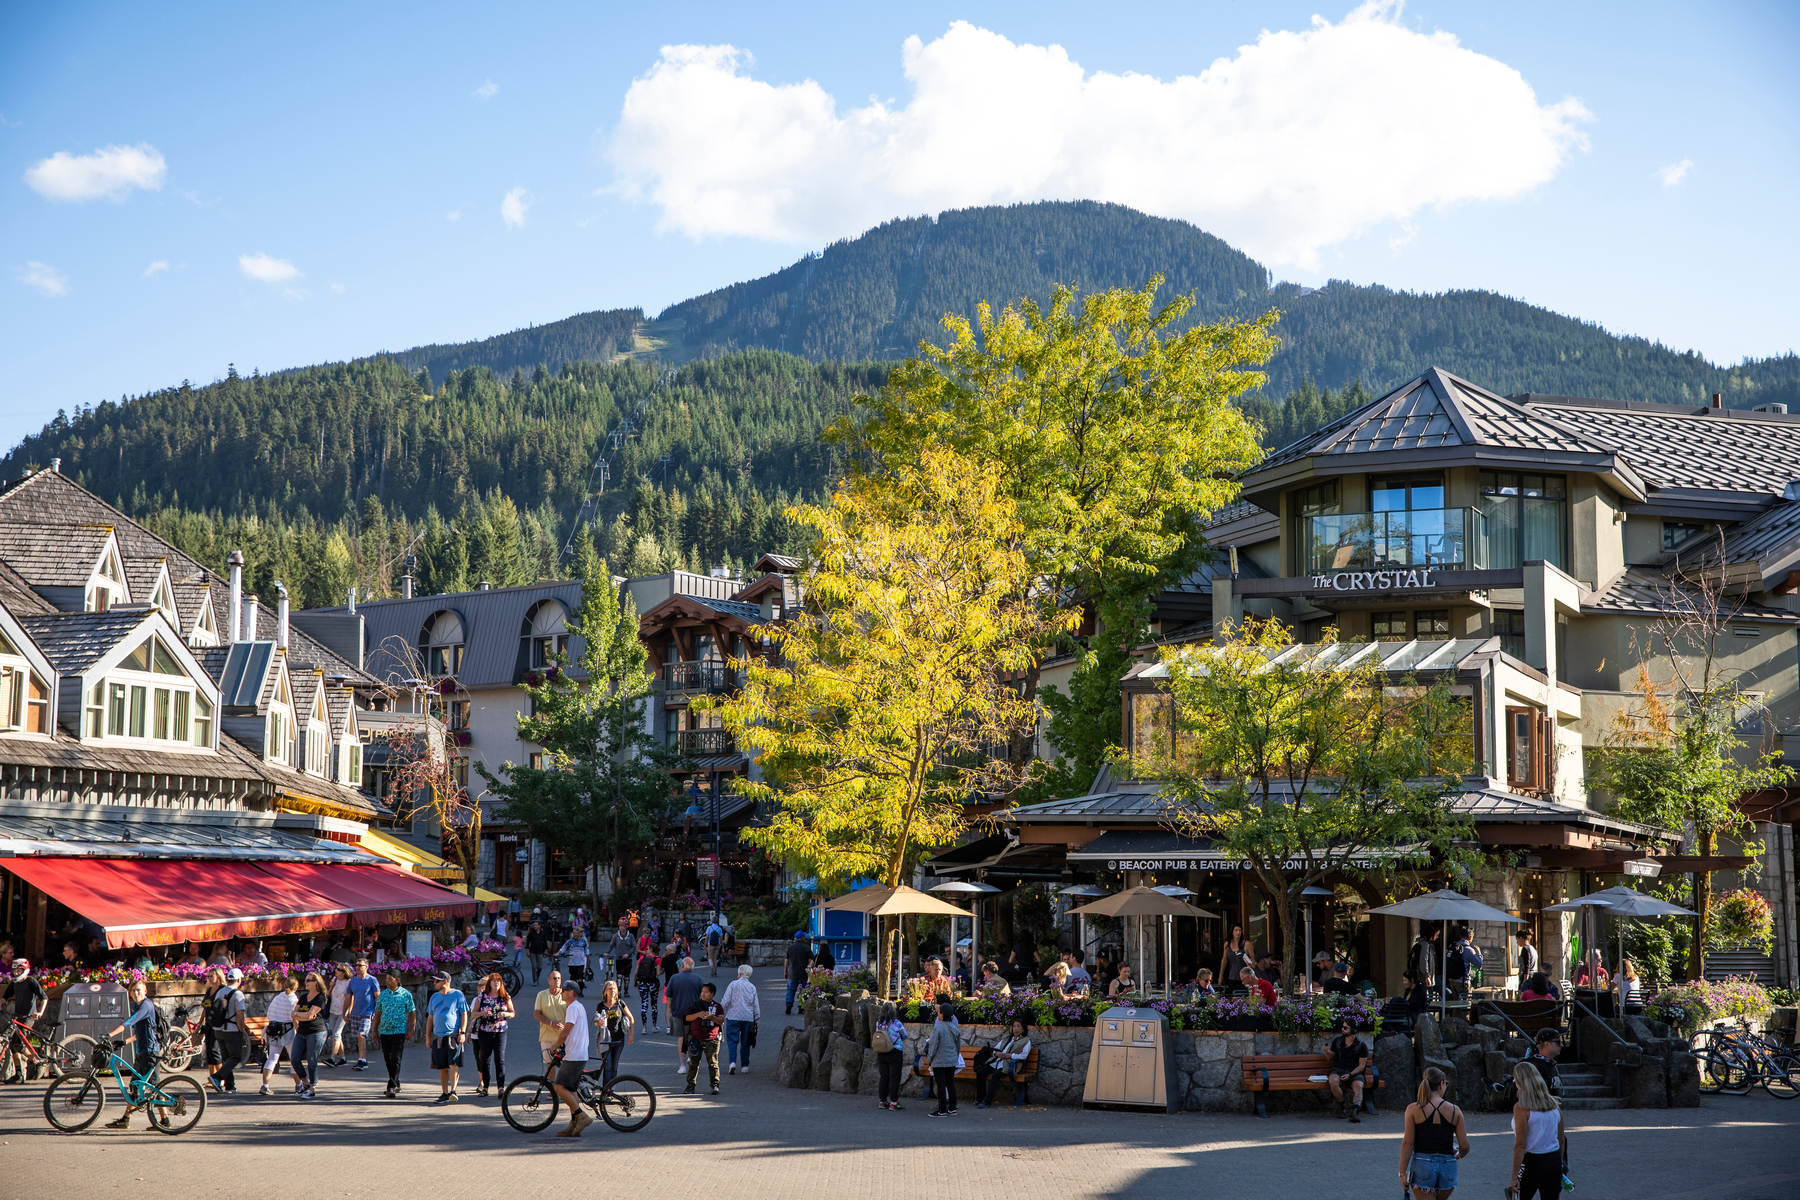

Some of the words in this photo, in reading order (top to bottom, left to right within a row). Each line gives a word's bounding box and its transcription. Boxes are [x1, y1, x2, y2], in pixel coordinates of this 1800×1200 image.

[1312, 574, 1332, 588] The
[1333, 570, 1436, 591] CRYSTAL
[499, 834, 518, 842] Roots
[1119, 860, 1163, 870] BEACON
[1165, 860, 1188, 870] PUB
[1189, 860, 1198, 870] &
[1199, 860, 1241, 870] EATERY
